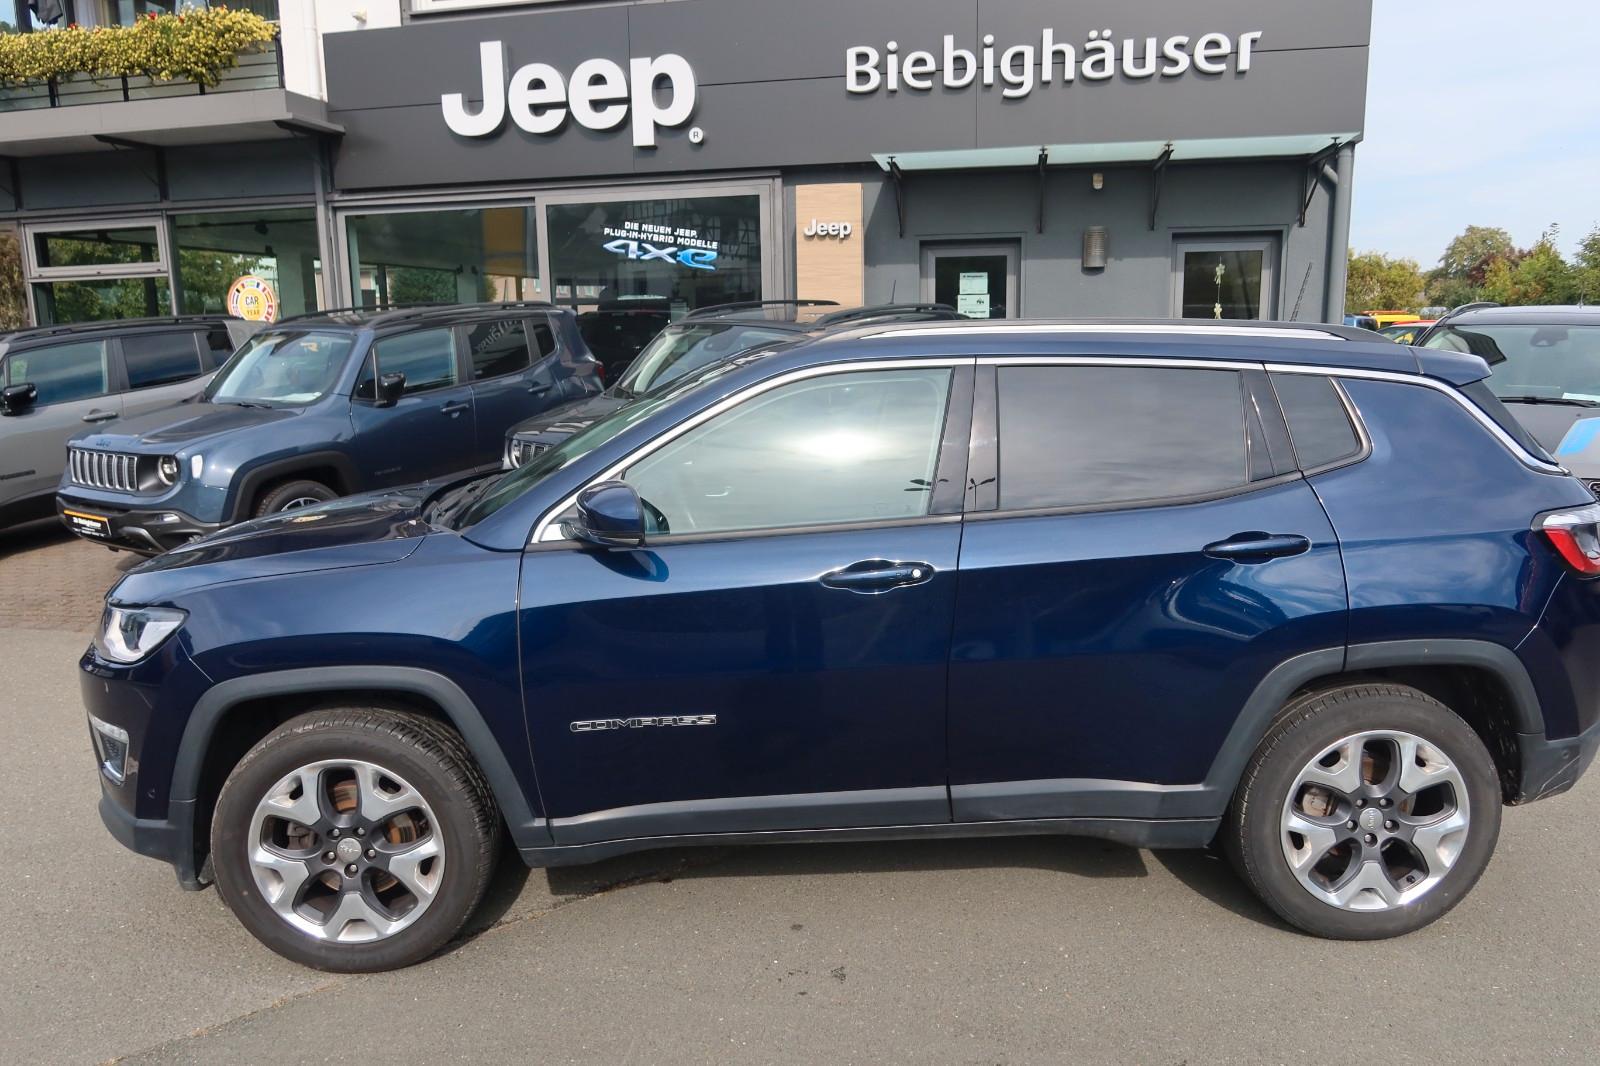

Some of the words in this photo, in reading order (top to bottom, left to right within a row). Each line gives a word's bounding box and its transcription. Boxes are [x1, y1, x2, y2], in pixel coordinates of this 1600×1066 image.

[846, 28, 1263, 98] Biebighäuser
[441, 40, 696, 147] Jeep
[603, 227, 674, 243] PLUG-IN-HYBRID
[676, 236, 718, 250] MODELLE
[624, 221, 639, 231] DIE
[641, 223, 672, 235] NEUEN
[803, 217, 852, 239] Jeep
[245, 296, 260, 305] CAR
[570, 714, 716, 732] COMPASS
